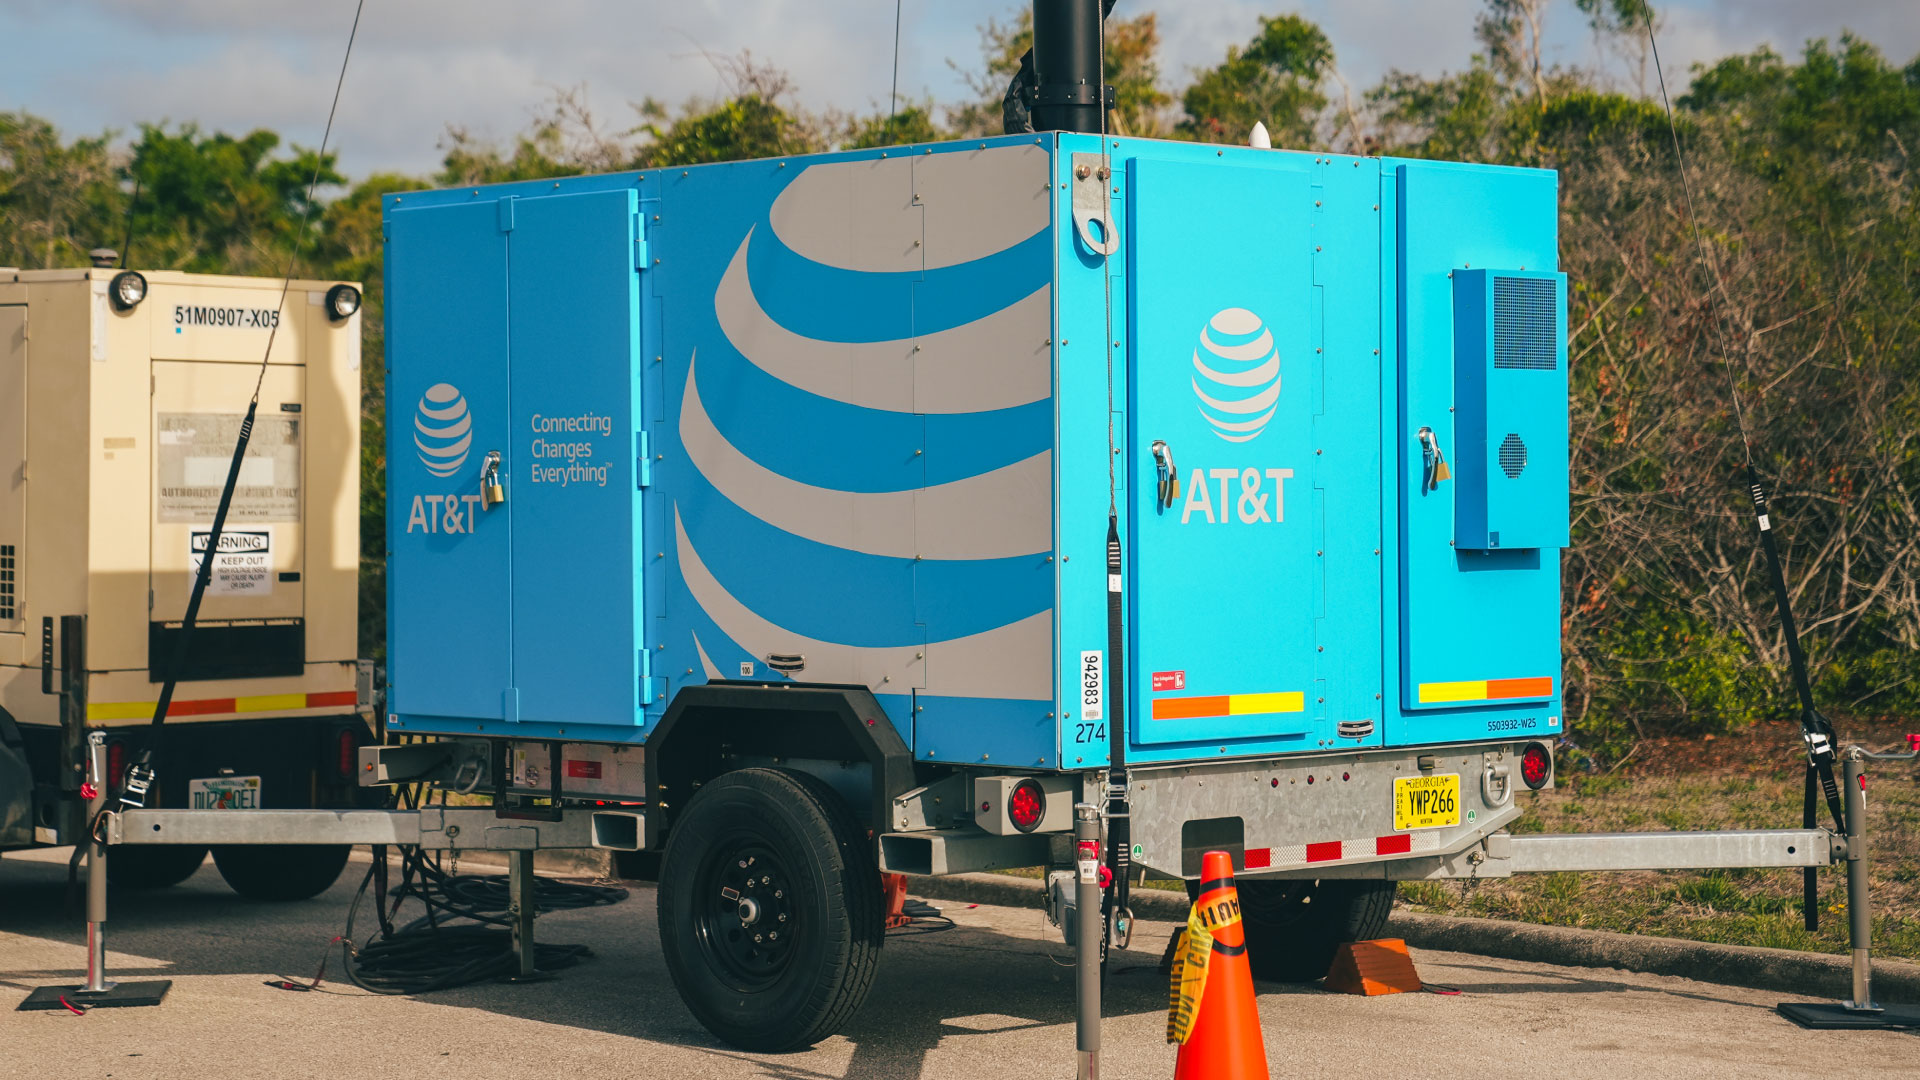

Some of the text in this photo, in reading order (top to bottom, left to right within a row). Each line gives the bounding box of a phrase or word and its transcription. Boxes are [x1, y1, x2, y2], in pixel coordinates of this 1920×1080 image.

[175, 306, 279, 329] 51M0907-X05
[531, 412, 611, 436] Connecting
[531, 438, 592, 463] Changes
[1181, 467, 1294, 524] AT&T
[406, 494, 481, 534] AT&T
[200, 536, 261, 548] WRNING
[221, 556, 264, 565] KEEP OUT
[1084, 655, 1099, 705] 942983
[1075, 722, 1106, 743] 274
[1409, 777, 1445, 788] GEORGIA
[1409, 788, 1454, 816] YWP266
